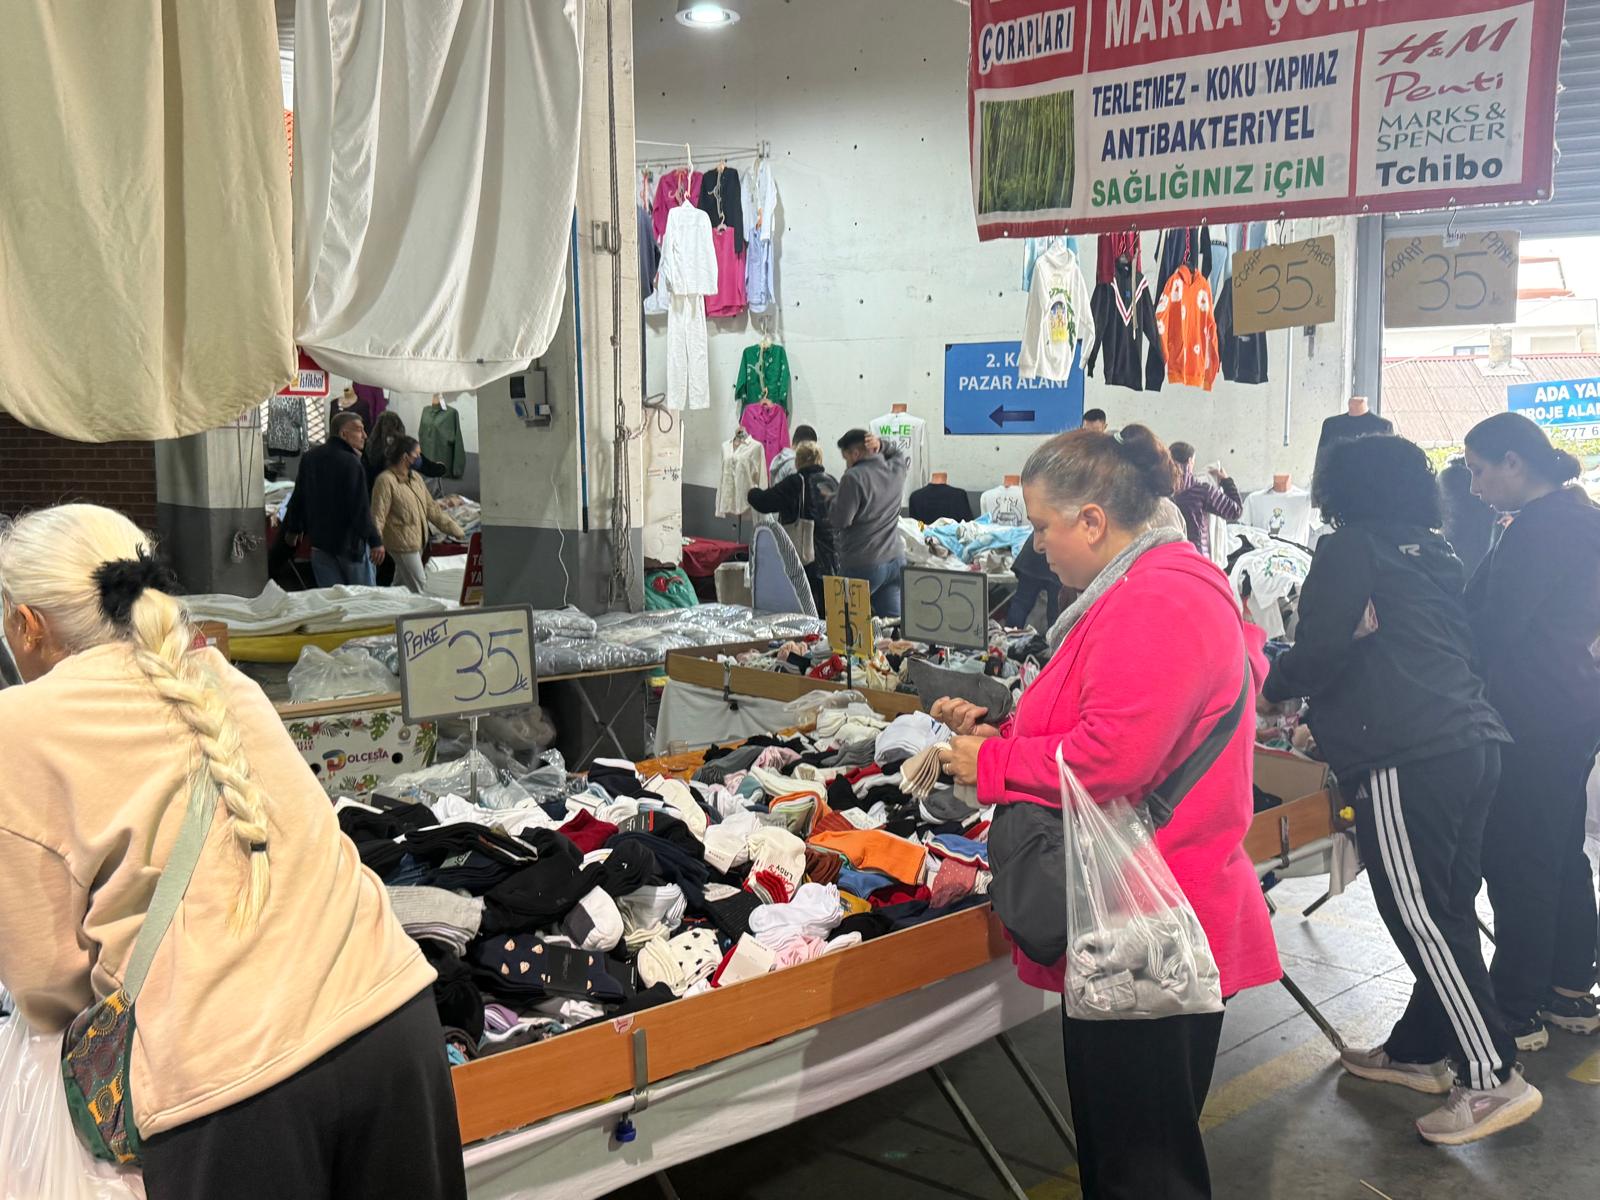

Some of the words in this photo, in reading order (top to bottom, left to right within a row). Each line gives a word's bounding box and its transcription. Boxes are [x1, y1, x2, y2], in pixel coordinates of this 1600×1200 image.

[981, 11, 1073, 70] ÇORAPLARI
[1377, 16, 1519, 67] H&M
[1092, 72, 1187, 118] TERLETMEZ
[1206, 61, 1258, 102] KOKU
[1264, 49, 1339, 94] YAPMAZ
[1375, 71, 1504, 108] Penti
[1378, 104, 1480, 133] MARKS
[1485, 102, 1506, 121] &
[1376, 122, 1506, 153] SPENCER
[1091, 163, 1254, 208] SAĞLIĞINIZ
[1375, 153, 1504, 188] Tchibo
[985, 354, 1001, 368] 2.
[958, 375, 1013, 391] PAZAR
[1534, 384, 1570, 404] ADA
[403, 619, 449, 657] PAKET
